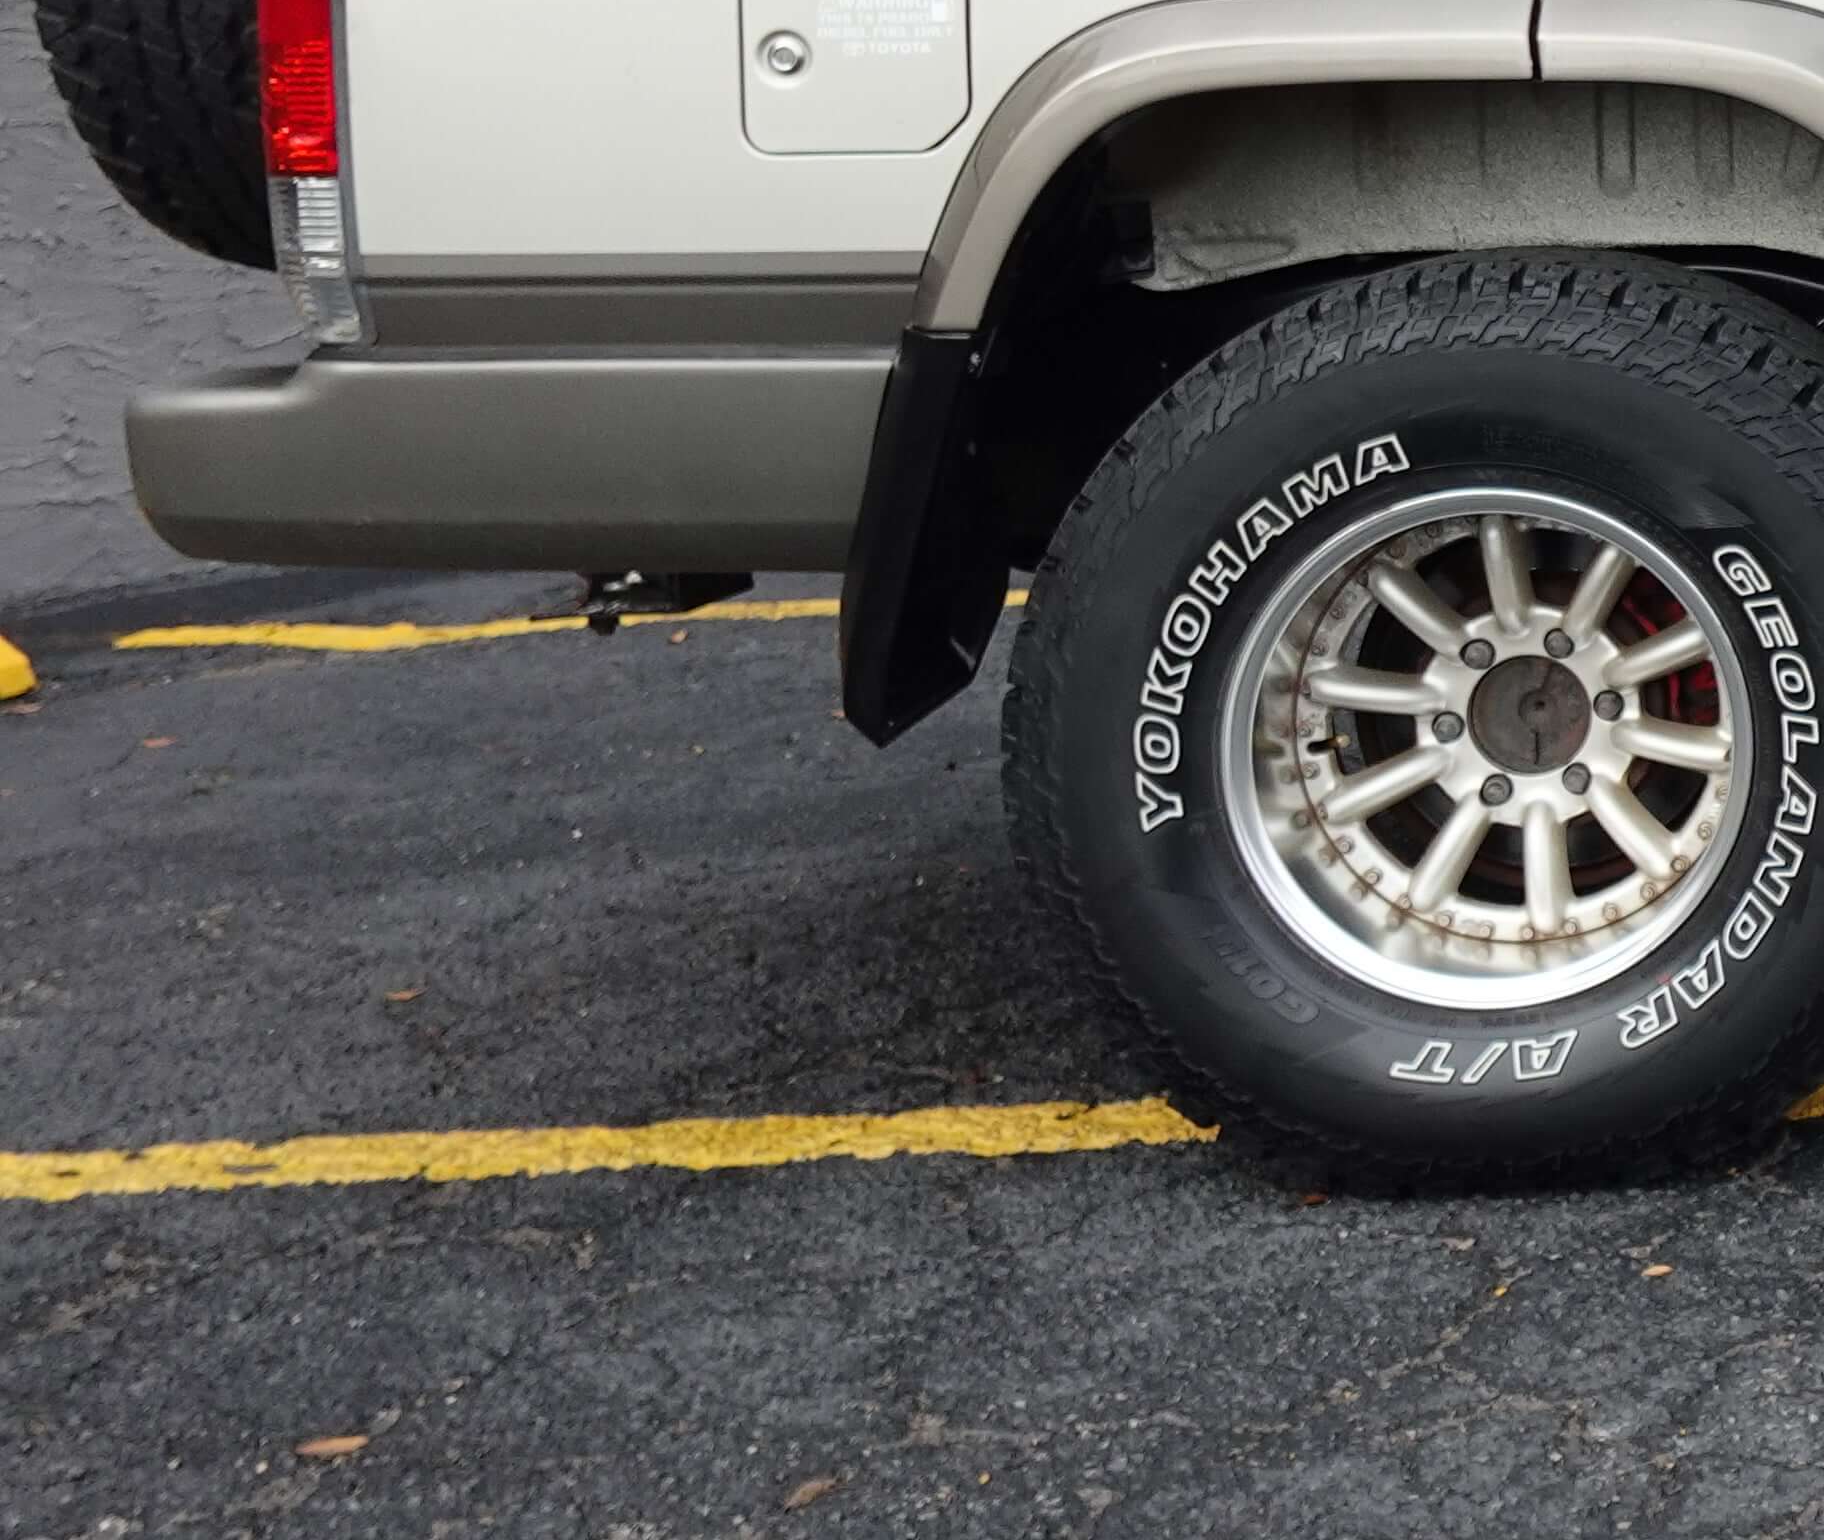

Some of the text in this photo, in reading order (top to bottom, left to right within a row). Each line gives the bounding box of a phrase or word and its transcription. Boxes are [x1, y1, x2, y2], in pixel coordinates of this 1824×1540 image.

[868, 42, 932, 54] TOYOTA
[1133, 433, 1410, 834] YOKOHAMA
[1389, 544, 1820, 1084] GEOLANDAR A/T
